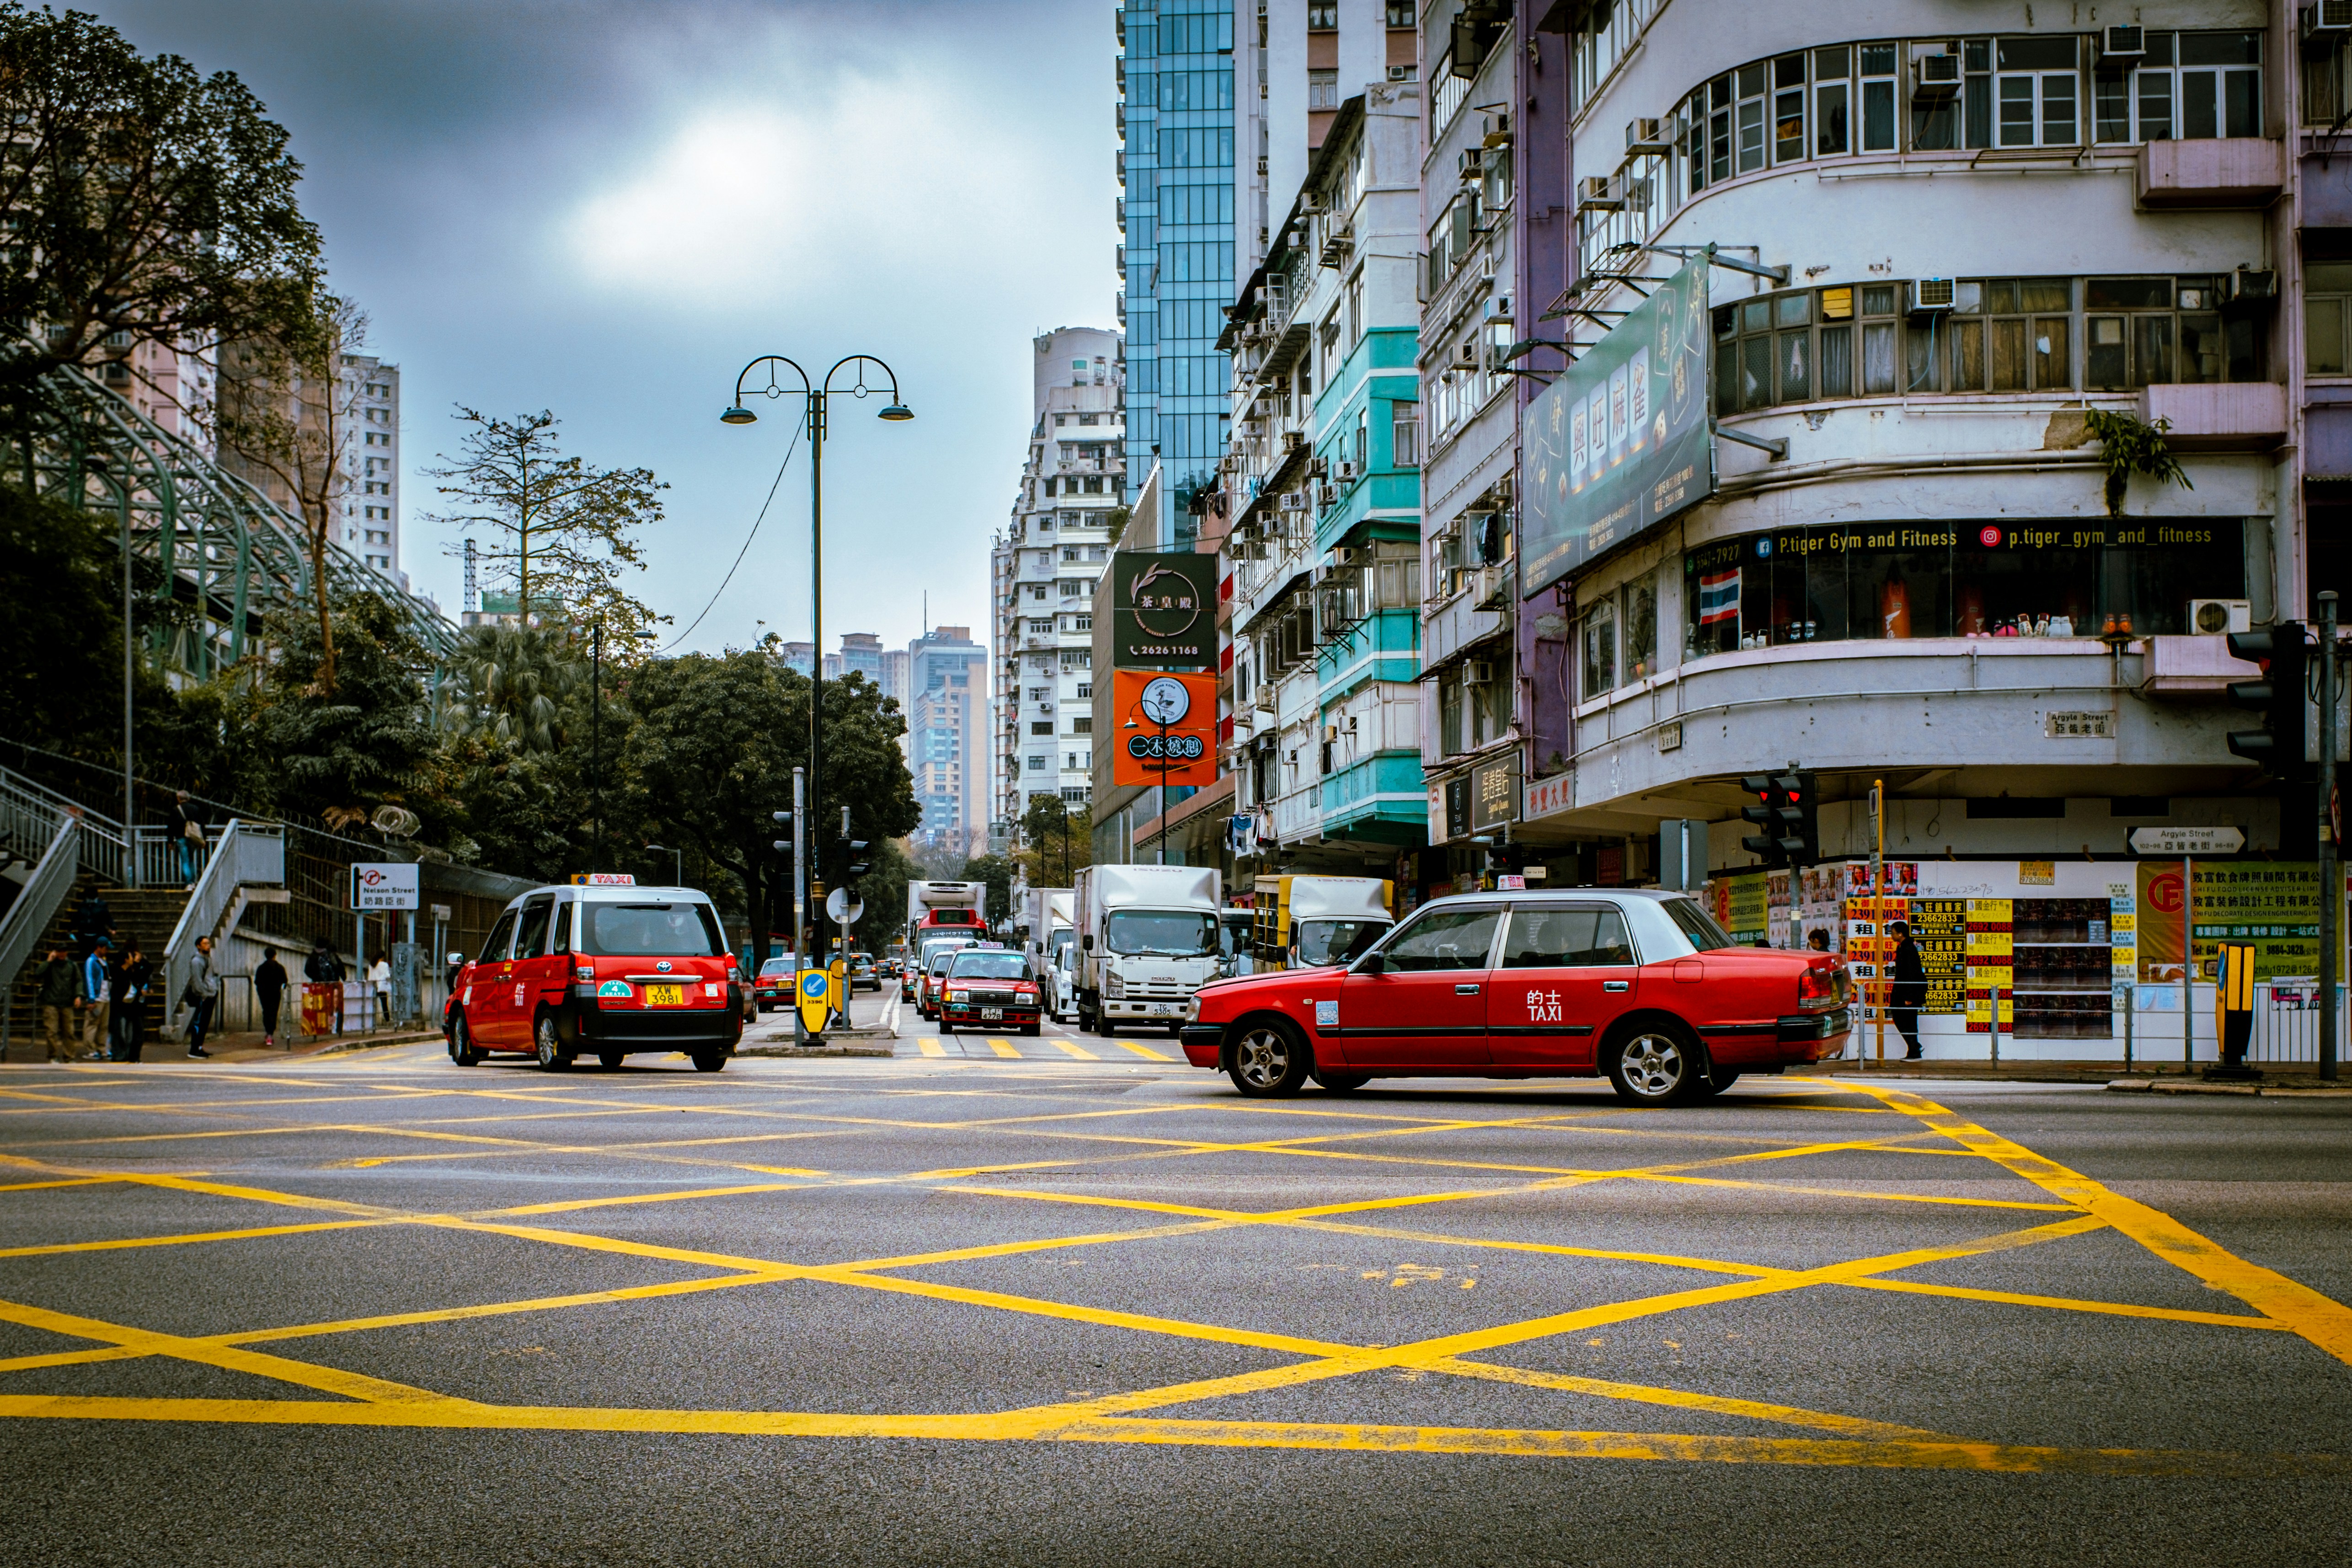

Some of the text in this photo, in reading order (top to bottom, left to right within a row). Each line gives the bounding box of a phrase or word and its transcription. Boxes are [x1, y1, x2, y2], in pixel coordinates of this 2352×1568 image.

[1573, 362, 1645, 470] 興旺麻雀
[1780, 530, 1957, 555] P.tiger Gym and Fitness
[2010, 527, 2211, 549] p.tiger_gym_and_fitness
[1696, 544, 1739, 570] 5547-7927
[1142, 646, 1198, 655] 2626 1168
[2055, 724, 2105, 733] 亞皆老街
[1132, 739, 1199, 754] 一木燒鵝
[2160, 830, 2186, 839] Argyle
[2165, 841, 2210, 850] 亞皆老街
[595, 875, 631, 884] TAXI
[1508, 876, 1524, 887] TAXI
[2192, 871, 2320, 883] 致富飲食牌照顧問有限公
[364, 897, 405, 906] 奶路臣街
[1975, 900, 1997, 911] 國金行
[2192, 895, 2320, 907] 致富裝飾設計工程有限公
[1851, 909, 1875, 920] 2391
[1855, 924, 1874, 935] 租
[1968, 922, 2012, 931] 2692 0088
[1975, 934, 1997, 944] 國金行
[2192, 945, 2204, 955] Tel:
[2207, 945, 2218, 955] 644
[2266, 945, 2304, 955] 9884-3828
[1851, 951, 1875, 962] 2391
[1968, 955, 2012, 964] 2692 0088
[1855, 966, 1874, 976] 租
[1975, 967, 1997, 977] 國金行
[2254, 965, 2320, 974] zhifu1972@126.c
[515, 982, 525, 994] 的士
[657, 986, 672, 995] XW
[1527, 990, 1561, 1005] 的士
[1851, 992, 1875, 1003] 291
[1968, 989, 2012, 998] 2692 088
[514, 994, 524, 1006] TAXI
[652, 995, 679, 1004] 3981
[1976, 1001, 1990, 1011] 國金
[1527, 1006, 1561, 1021] TAXI
[1968, 1022, 2012, 1031] 2692 088
